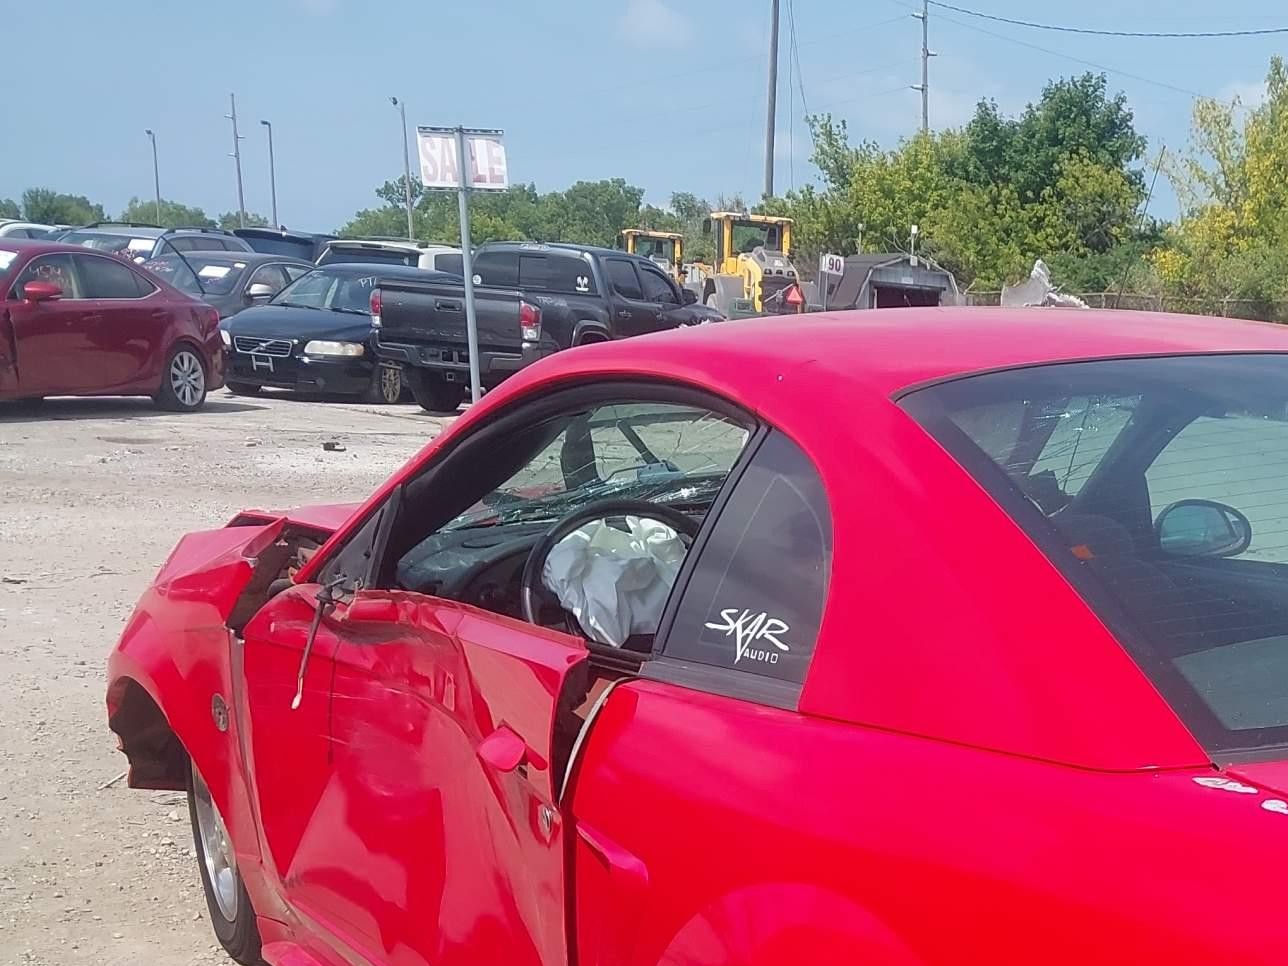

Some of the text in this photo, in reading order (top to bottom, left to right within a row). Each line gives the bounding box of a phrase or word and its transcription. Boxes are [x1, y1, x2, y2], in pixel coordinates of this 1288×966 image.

[422, 138, 505, 183] SALE
[828, 256, 841, 272] 90
[704, 608, 789, 664] SKAR
[743, 648, 779, 664] AUDIO
